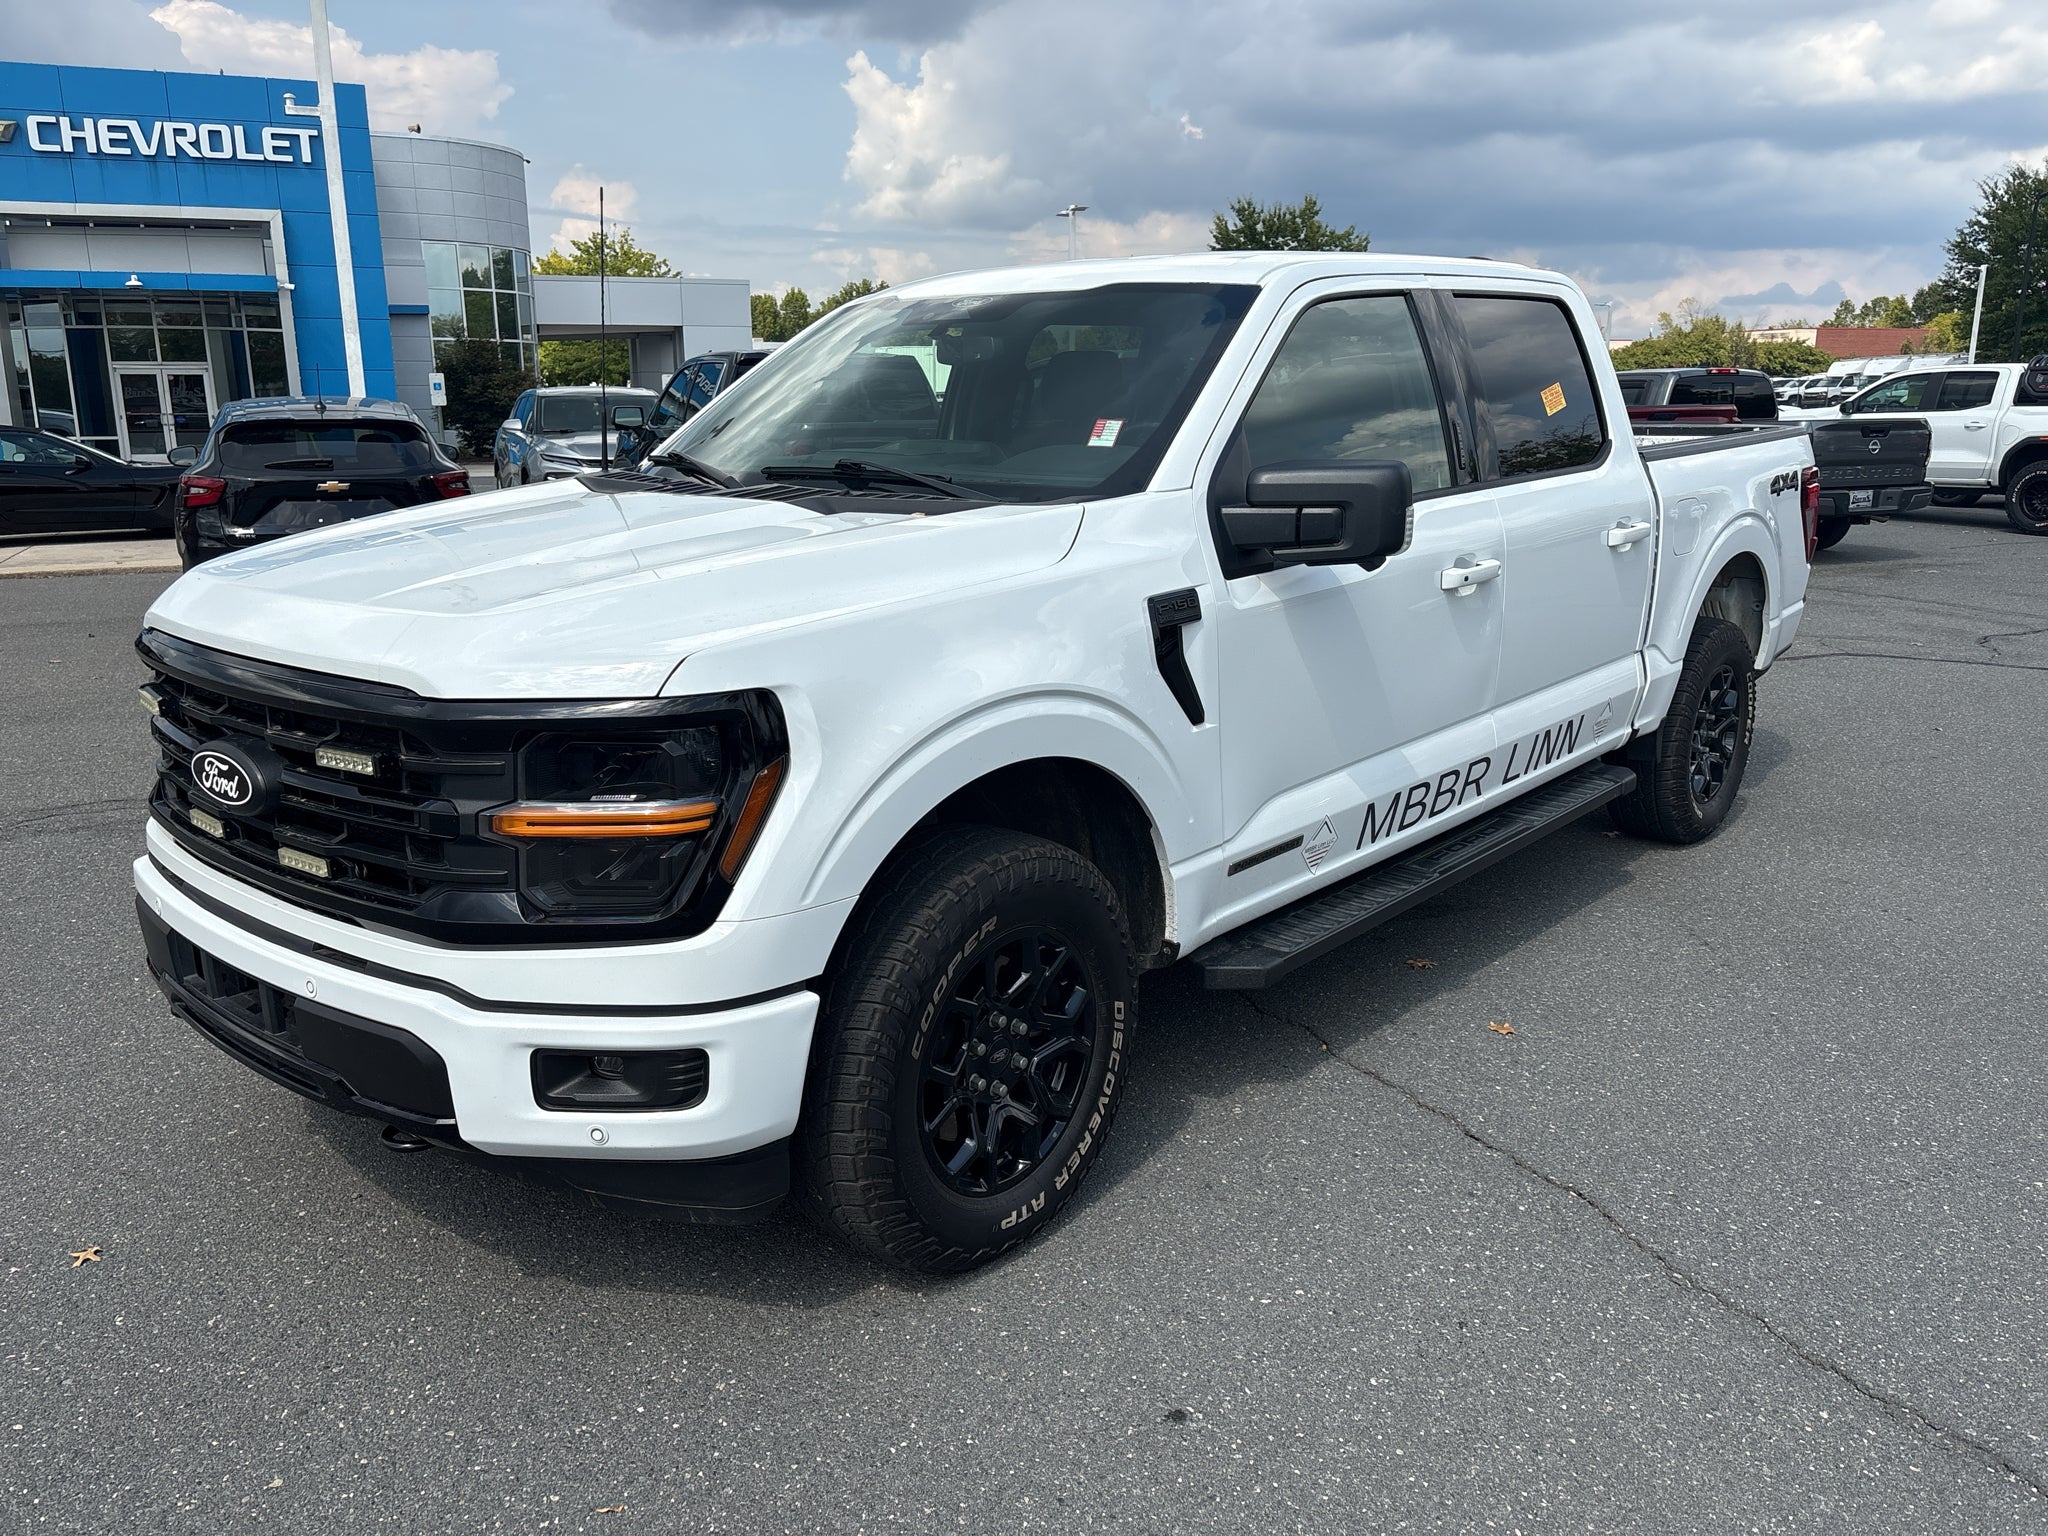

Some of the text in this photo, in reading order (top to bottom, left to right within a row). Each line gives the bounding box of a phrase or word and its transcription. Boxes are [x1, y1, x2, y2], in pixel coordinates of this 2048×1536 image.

[26, 115, 318, 163] CHEVROLET
[202, 757, 240, 799] Ford
[1356, 714, 1585, 851] MBBR LINN
[911, 915, 998, 1061] COOPER
[1001, 1000, 1125, 1231] DISCOVERER ATP
